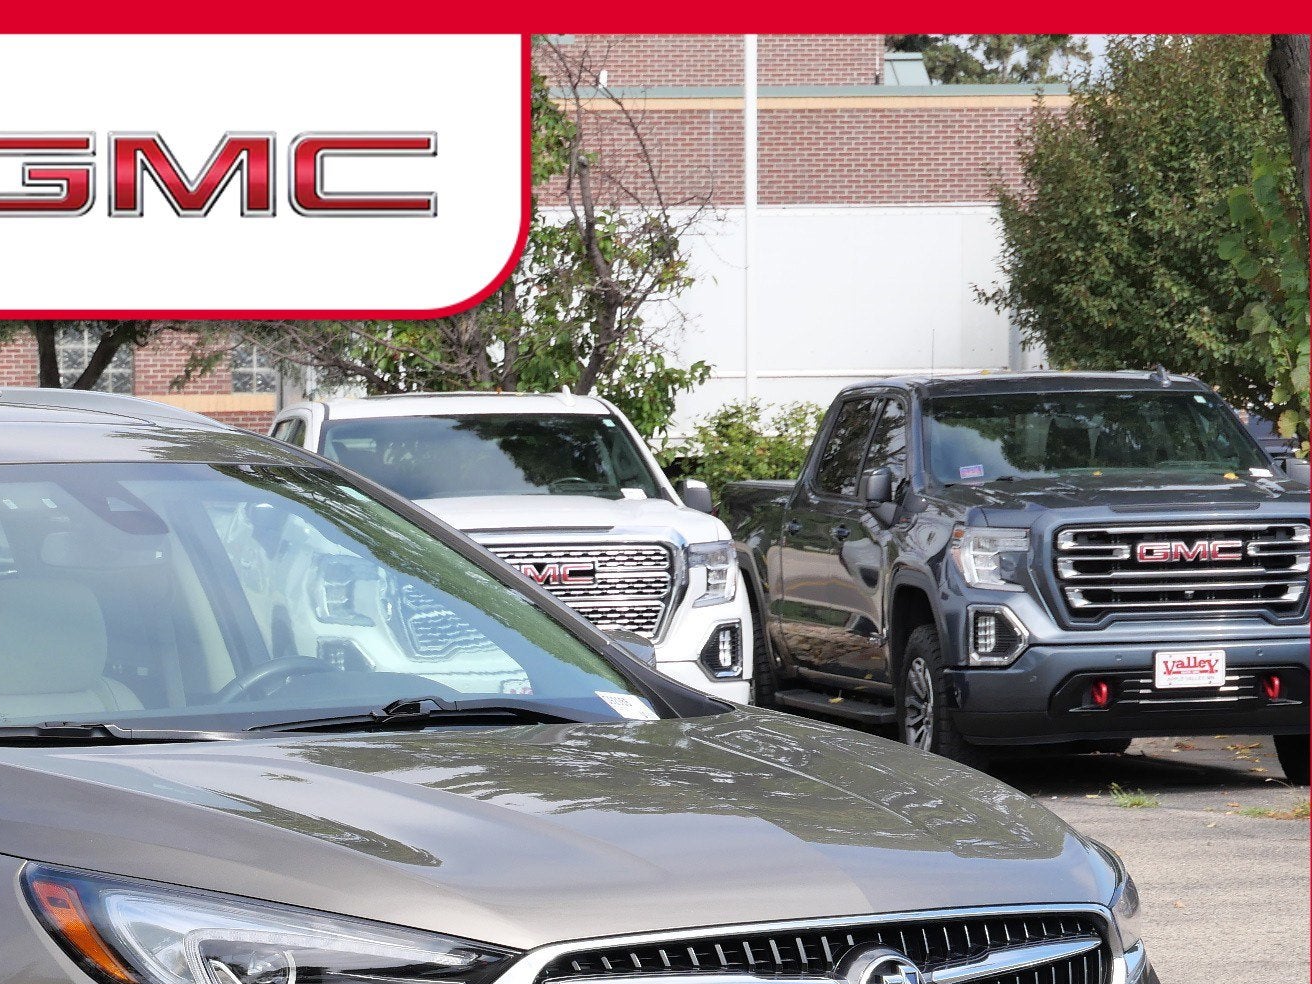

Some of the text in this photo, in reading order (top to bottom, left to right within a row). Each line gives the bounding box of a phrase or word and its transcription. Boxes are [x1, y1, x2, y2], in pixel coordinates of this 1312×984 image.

[1137, 540, 1243, 562] GMC
[512, 564, 594, 585] MC
[1163, 656, 1219, 675] Valley
